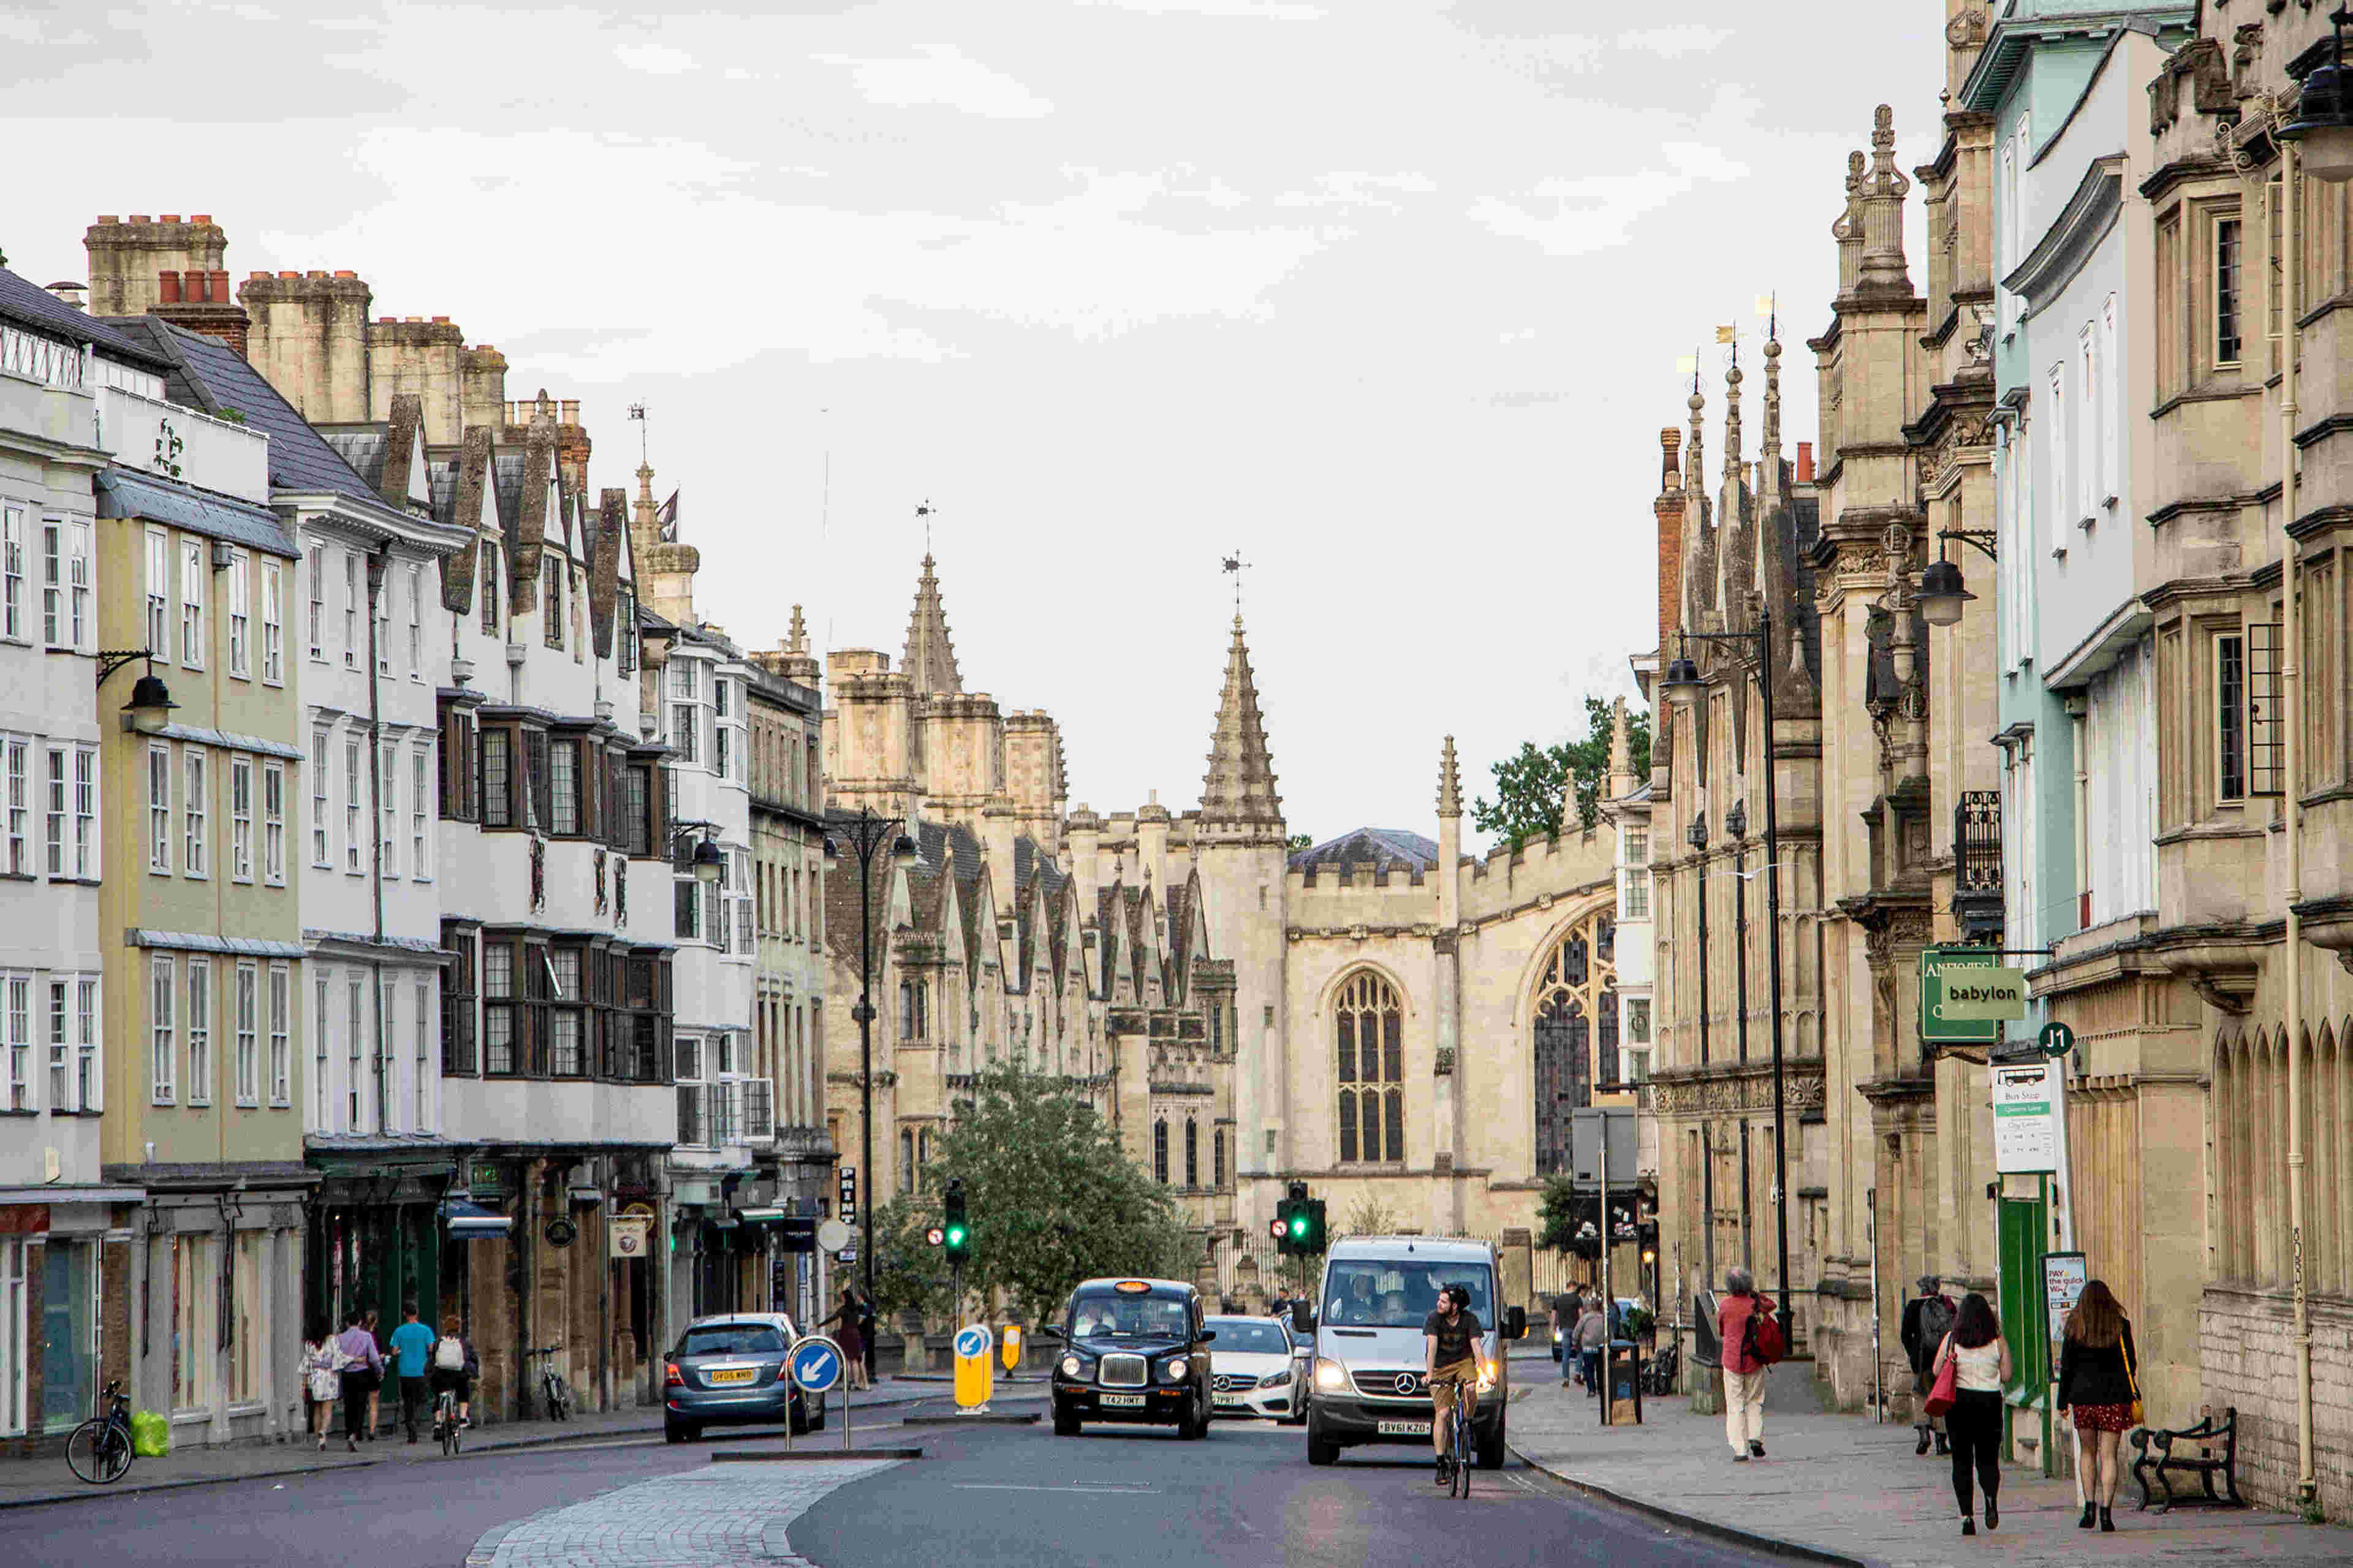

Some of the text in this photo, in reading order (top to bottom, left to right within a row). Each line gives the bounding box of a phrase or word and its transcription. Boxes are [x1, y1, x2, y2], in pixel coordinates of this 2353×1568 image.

[1950, 985, 2017, 1003] babylon
[2047, 1029, 2064, 1047] J1
[841, 1168, 854, 1224] PRINT
[1384, 1423, 1405, 1433] BV61
